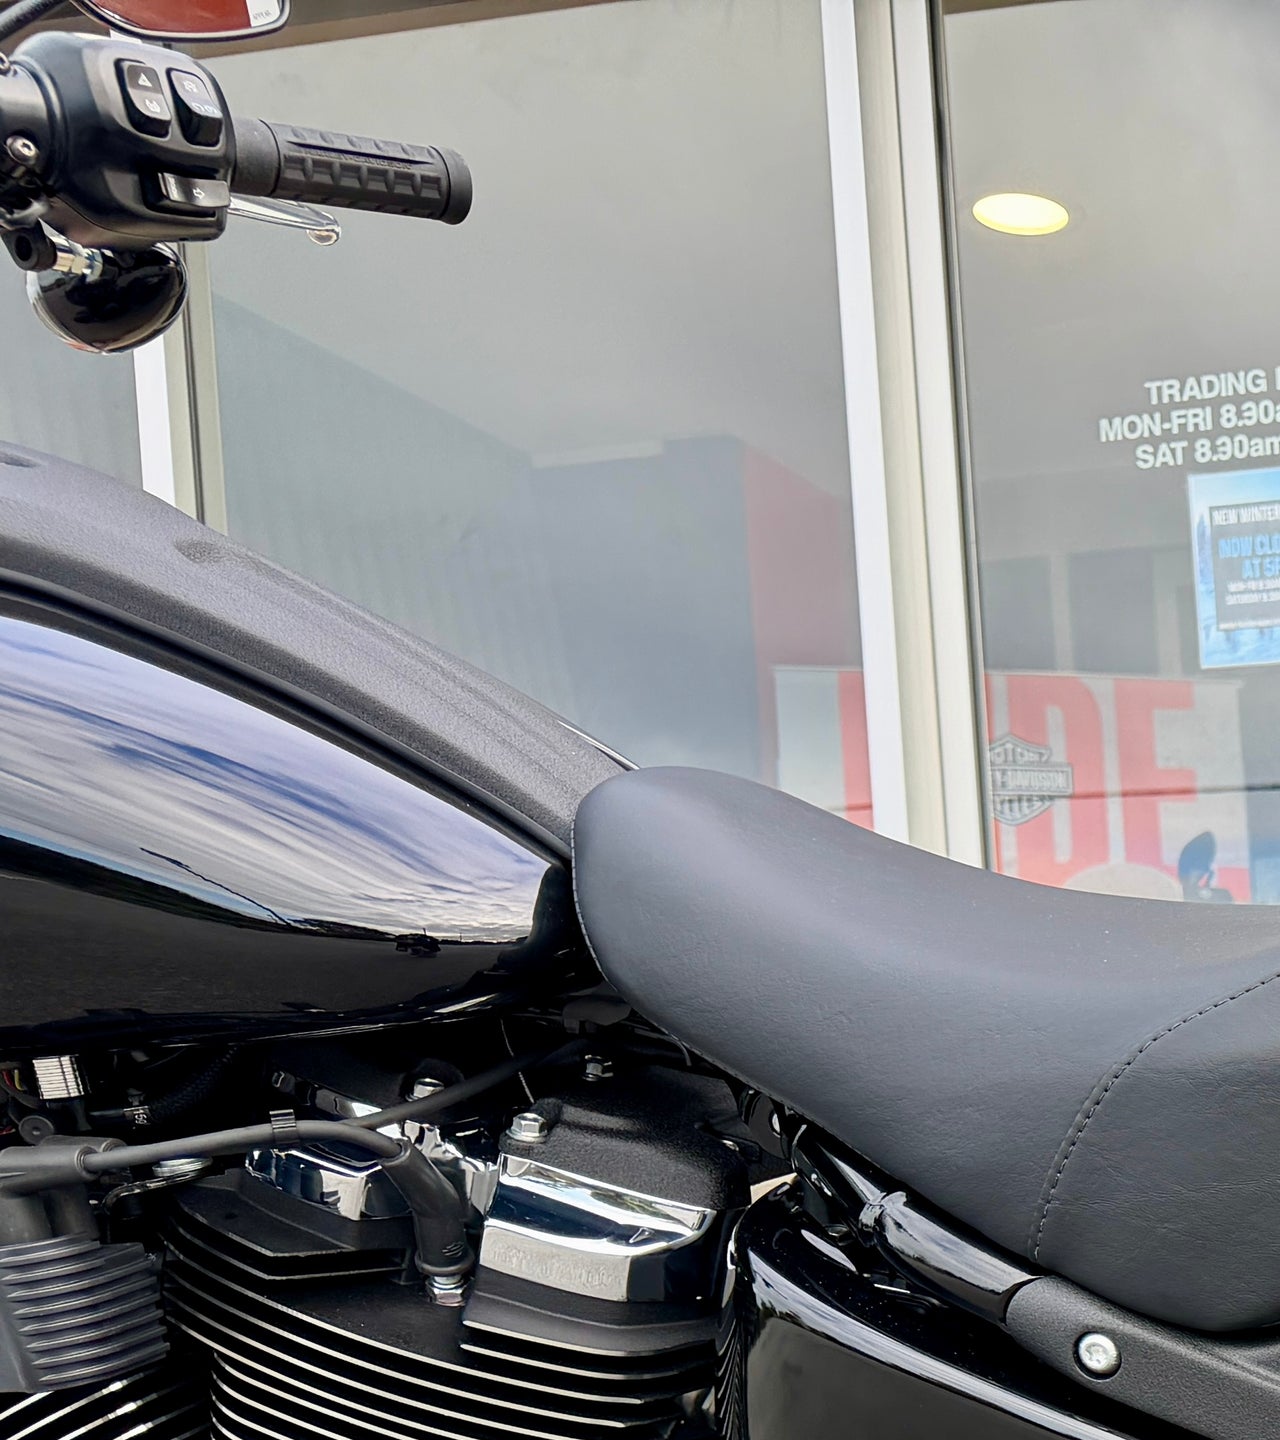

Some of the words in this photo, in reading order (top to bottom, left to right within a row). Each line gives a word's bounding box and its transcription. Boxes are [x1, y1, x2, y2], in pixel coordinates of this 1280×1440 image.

[1144, 368, 1267, 405] TRADING
[1099, 406, 1213, 443] MON-FRI
[1135, 441, 1188, 470] SAT
[1212, 509, 1238, 526] NEW
[1218, 536, 1253, 559] NOW
[1242, 558, 1261, 579] AT
